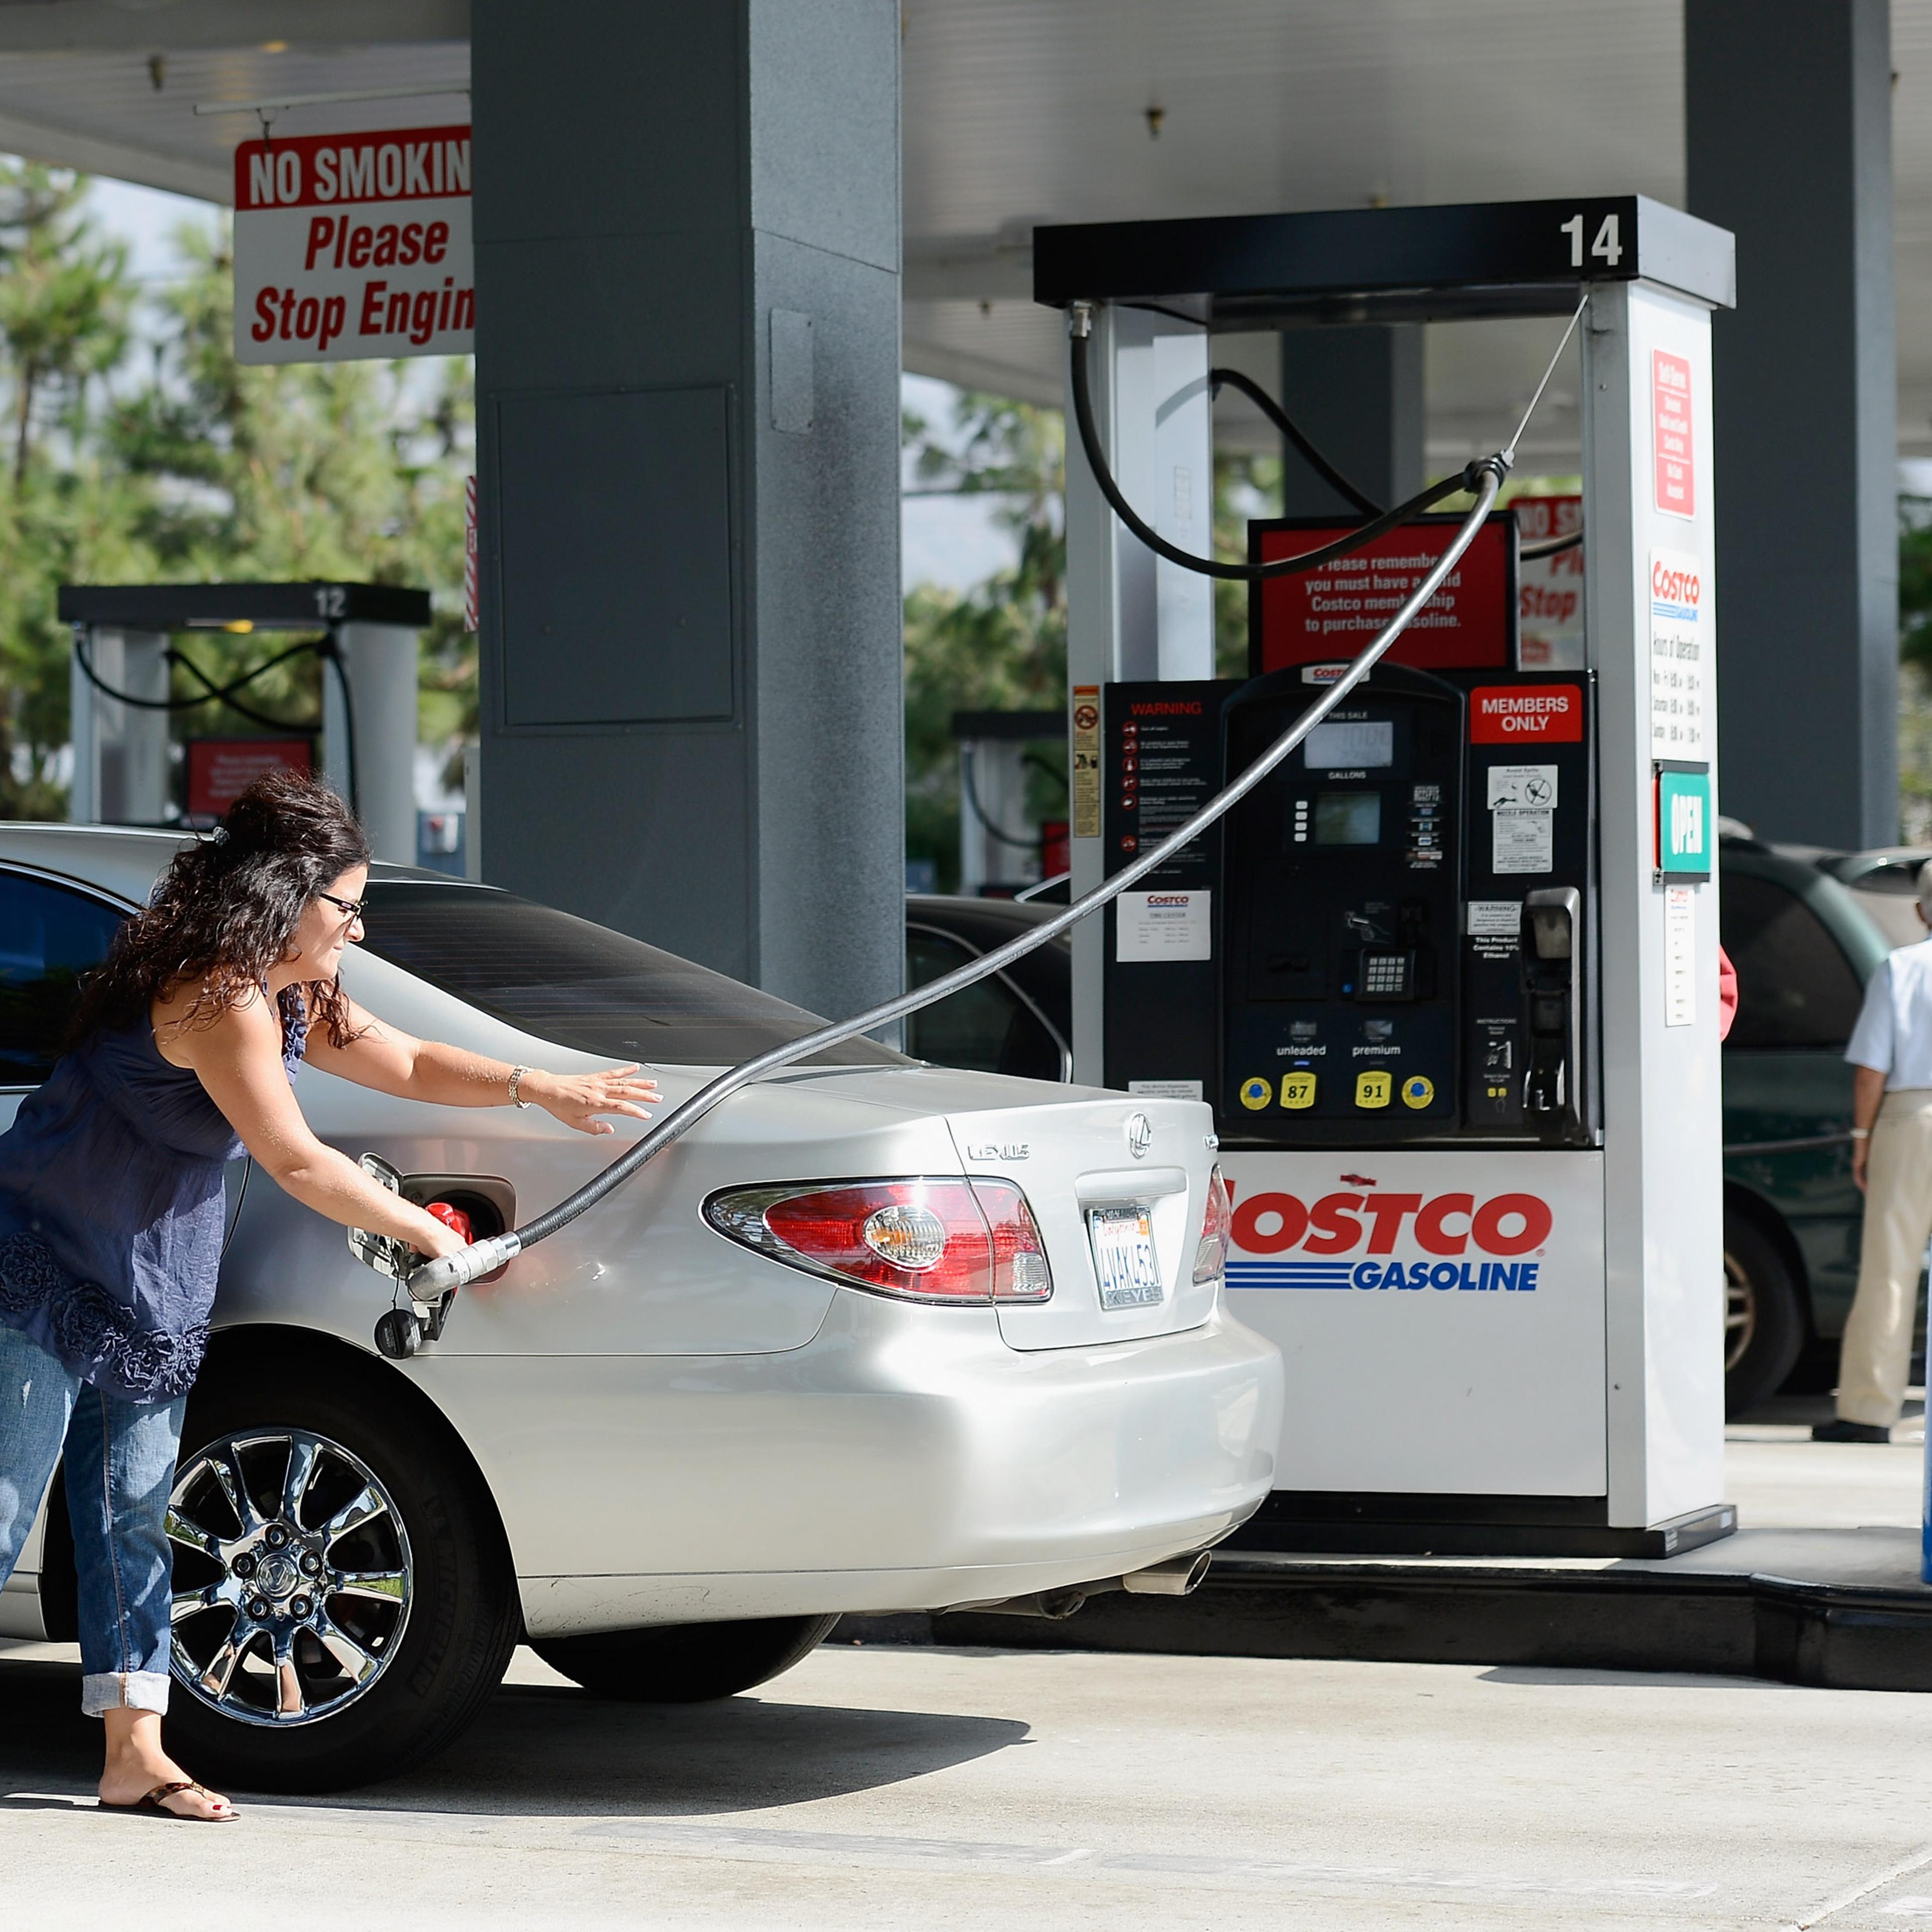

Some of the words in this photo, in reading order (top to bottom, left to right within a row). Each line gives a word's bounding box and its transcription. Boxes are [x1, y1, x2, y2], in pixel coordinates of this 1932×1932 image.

[250, 151, 301, 205] NO
[305, 215, 449, 270] Please
[1561, 214, 1623, 267] 14
[252, 287, 346, 351] Stop
[1371, 552, 1438, 570] remembe
[1305, 579, 1331, 596] you
[1334, 576, 1370, 591] must
[1374, 574, 1409, 590] have
[1439, 571, 1461, 588] lid
[1653, 560, 1700, 605] COSTCO
[314, 586, 347, 618] 12
[1311, 596, 1361, 612] Costco
[1305, 618, 1320, 632] to
[1313, 668, 1345, 678] COST
[1131, 701, 1202, 716] WARNING
[1482, 696, 1569, 714] MEMBERS
[1348, 710, 1369, 719] SALE
[1501, 715, 1549, 732] ONLY
[1328, 771, 1366, 780] GALLONS
[1147, 896, 1189, 905] COSTCO
[1276, 1045, 1326, 1056] unleaded
[1352, 1045, 1401, 1057] premium
[1287, 1086, 1308, 1098] 87
[1363, 1085, 1382, 1098] 91
[967, 1144, 1031, 1161] LEXUS
[1226, 1180, 1553, 1256] OSTCO
[1353, 1261, 1539, 1291] GASOLINE
